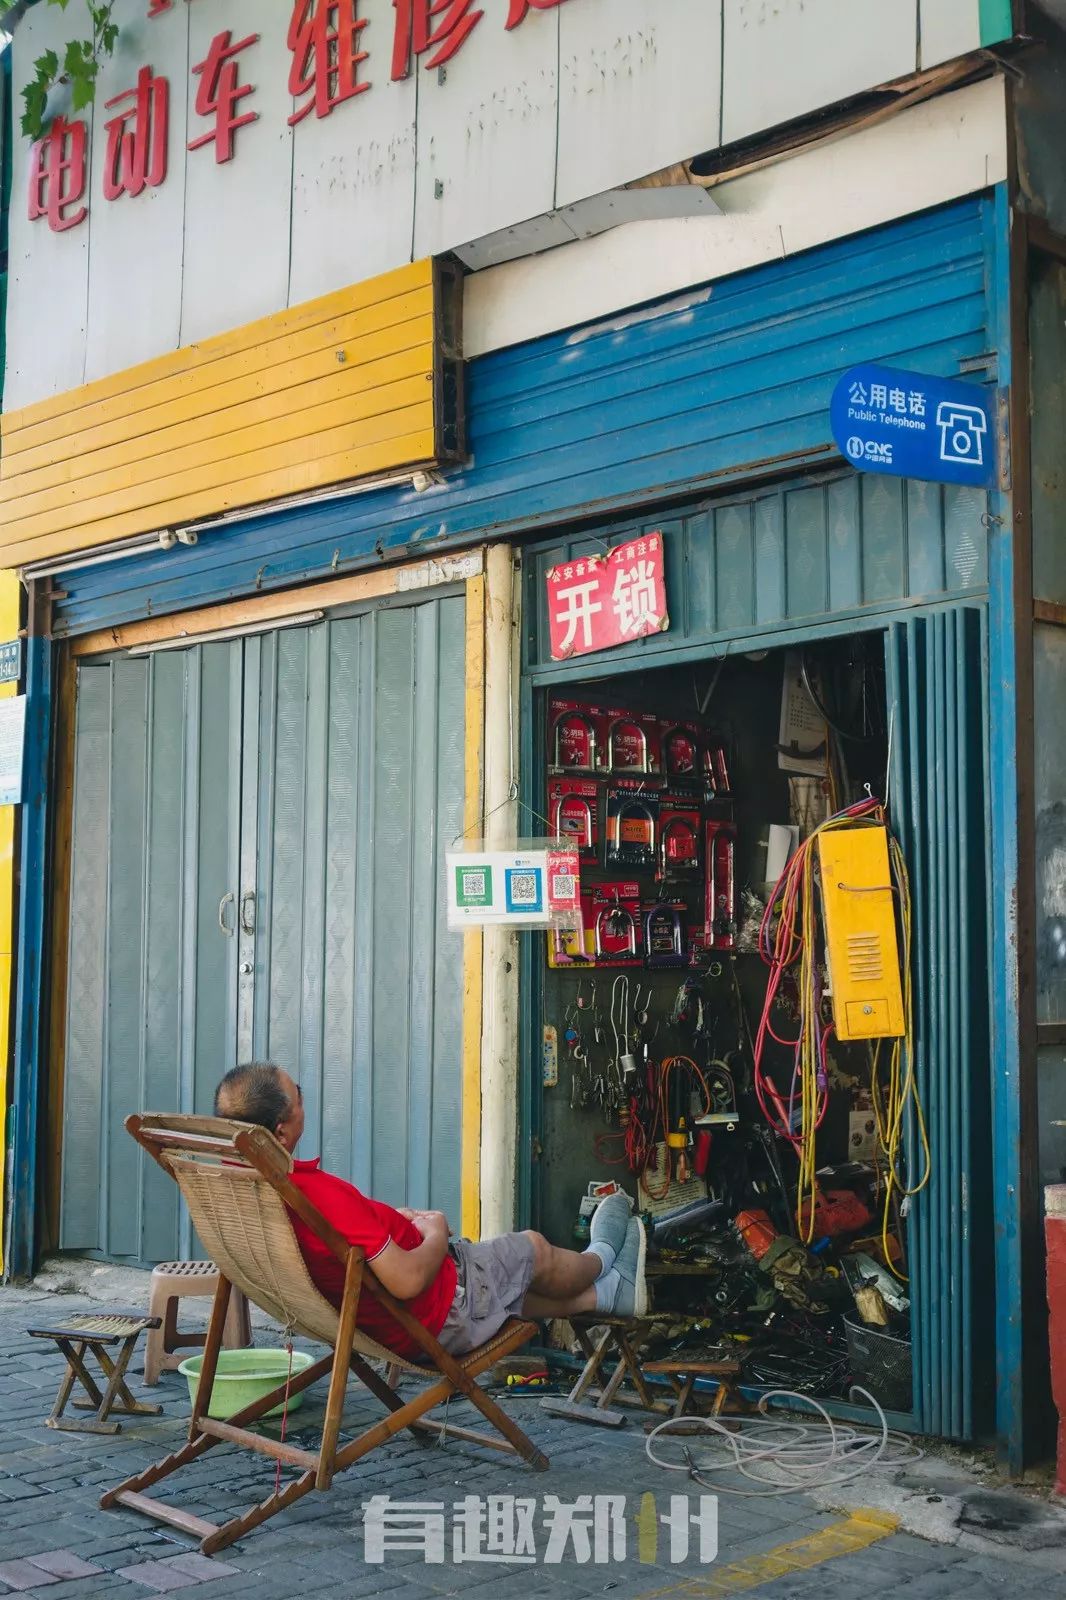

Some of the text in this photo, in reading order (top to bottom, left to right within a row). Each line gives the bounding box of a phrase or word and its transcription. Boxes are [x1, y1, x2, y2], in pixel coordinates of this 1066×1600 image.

[848, 381, 927, 416] 公用电话
[848, 408, 926, 430] Public Telephone
[865, 441, 893, 456] CNC
[551, 537, 659, 583] 公安备案 工商注册
[556, 560, 660, 650] 开锁
